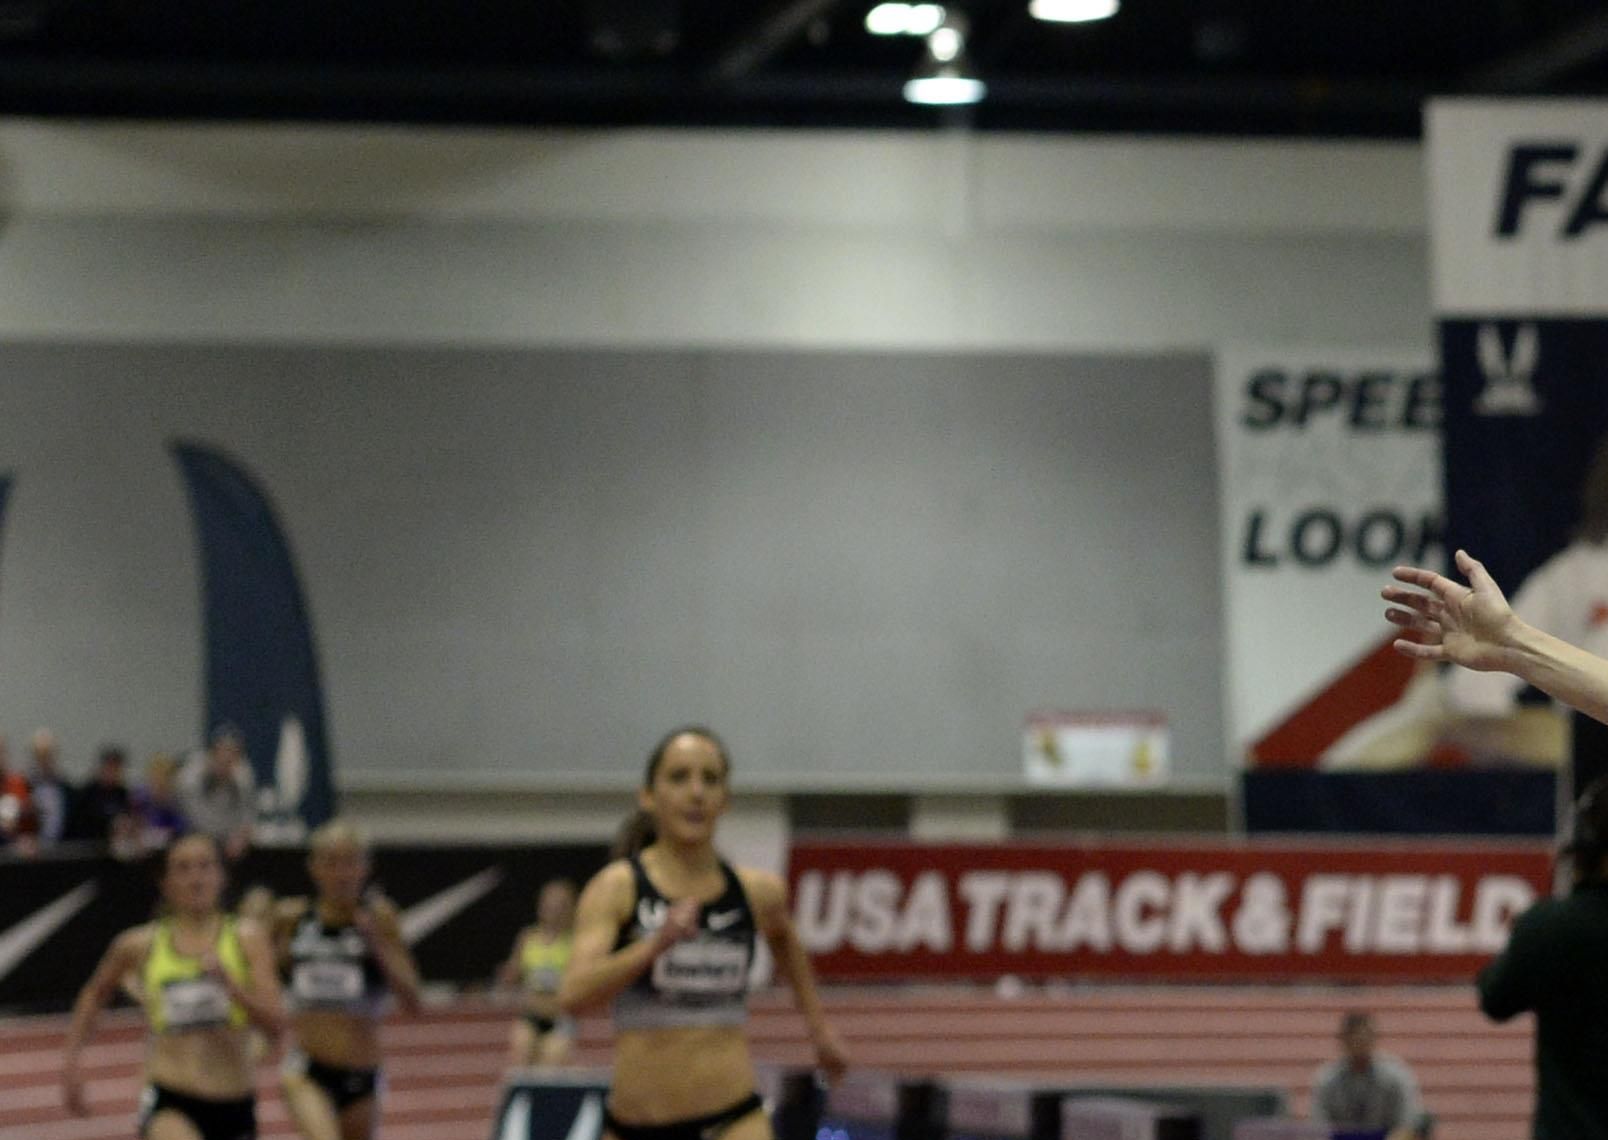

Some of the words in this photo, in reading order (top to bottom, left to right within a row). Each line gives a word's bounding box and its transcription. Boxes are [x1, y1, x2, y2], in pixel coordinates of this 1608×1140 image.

[796, 869, 952, 953] USA
[958, 869, 1238, 954] TRACK
[1298, 872, 1536, 954] FIELD
